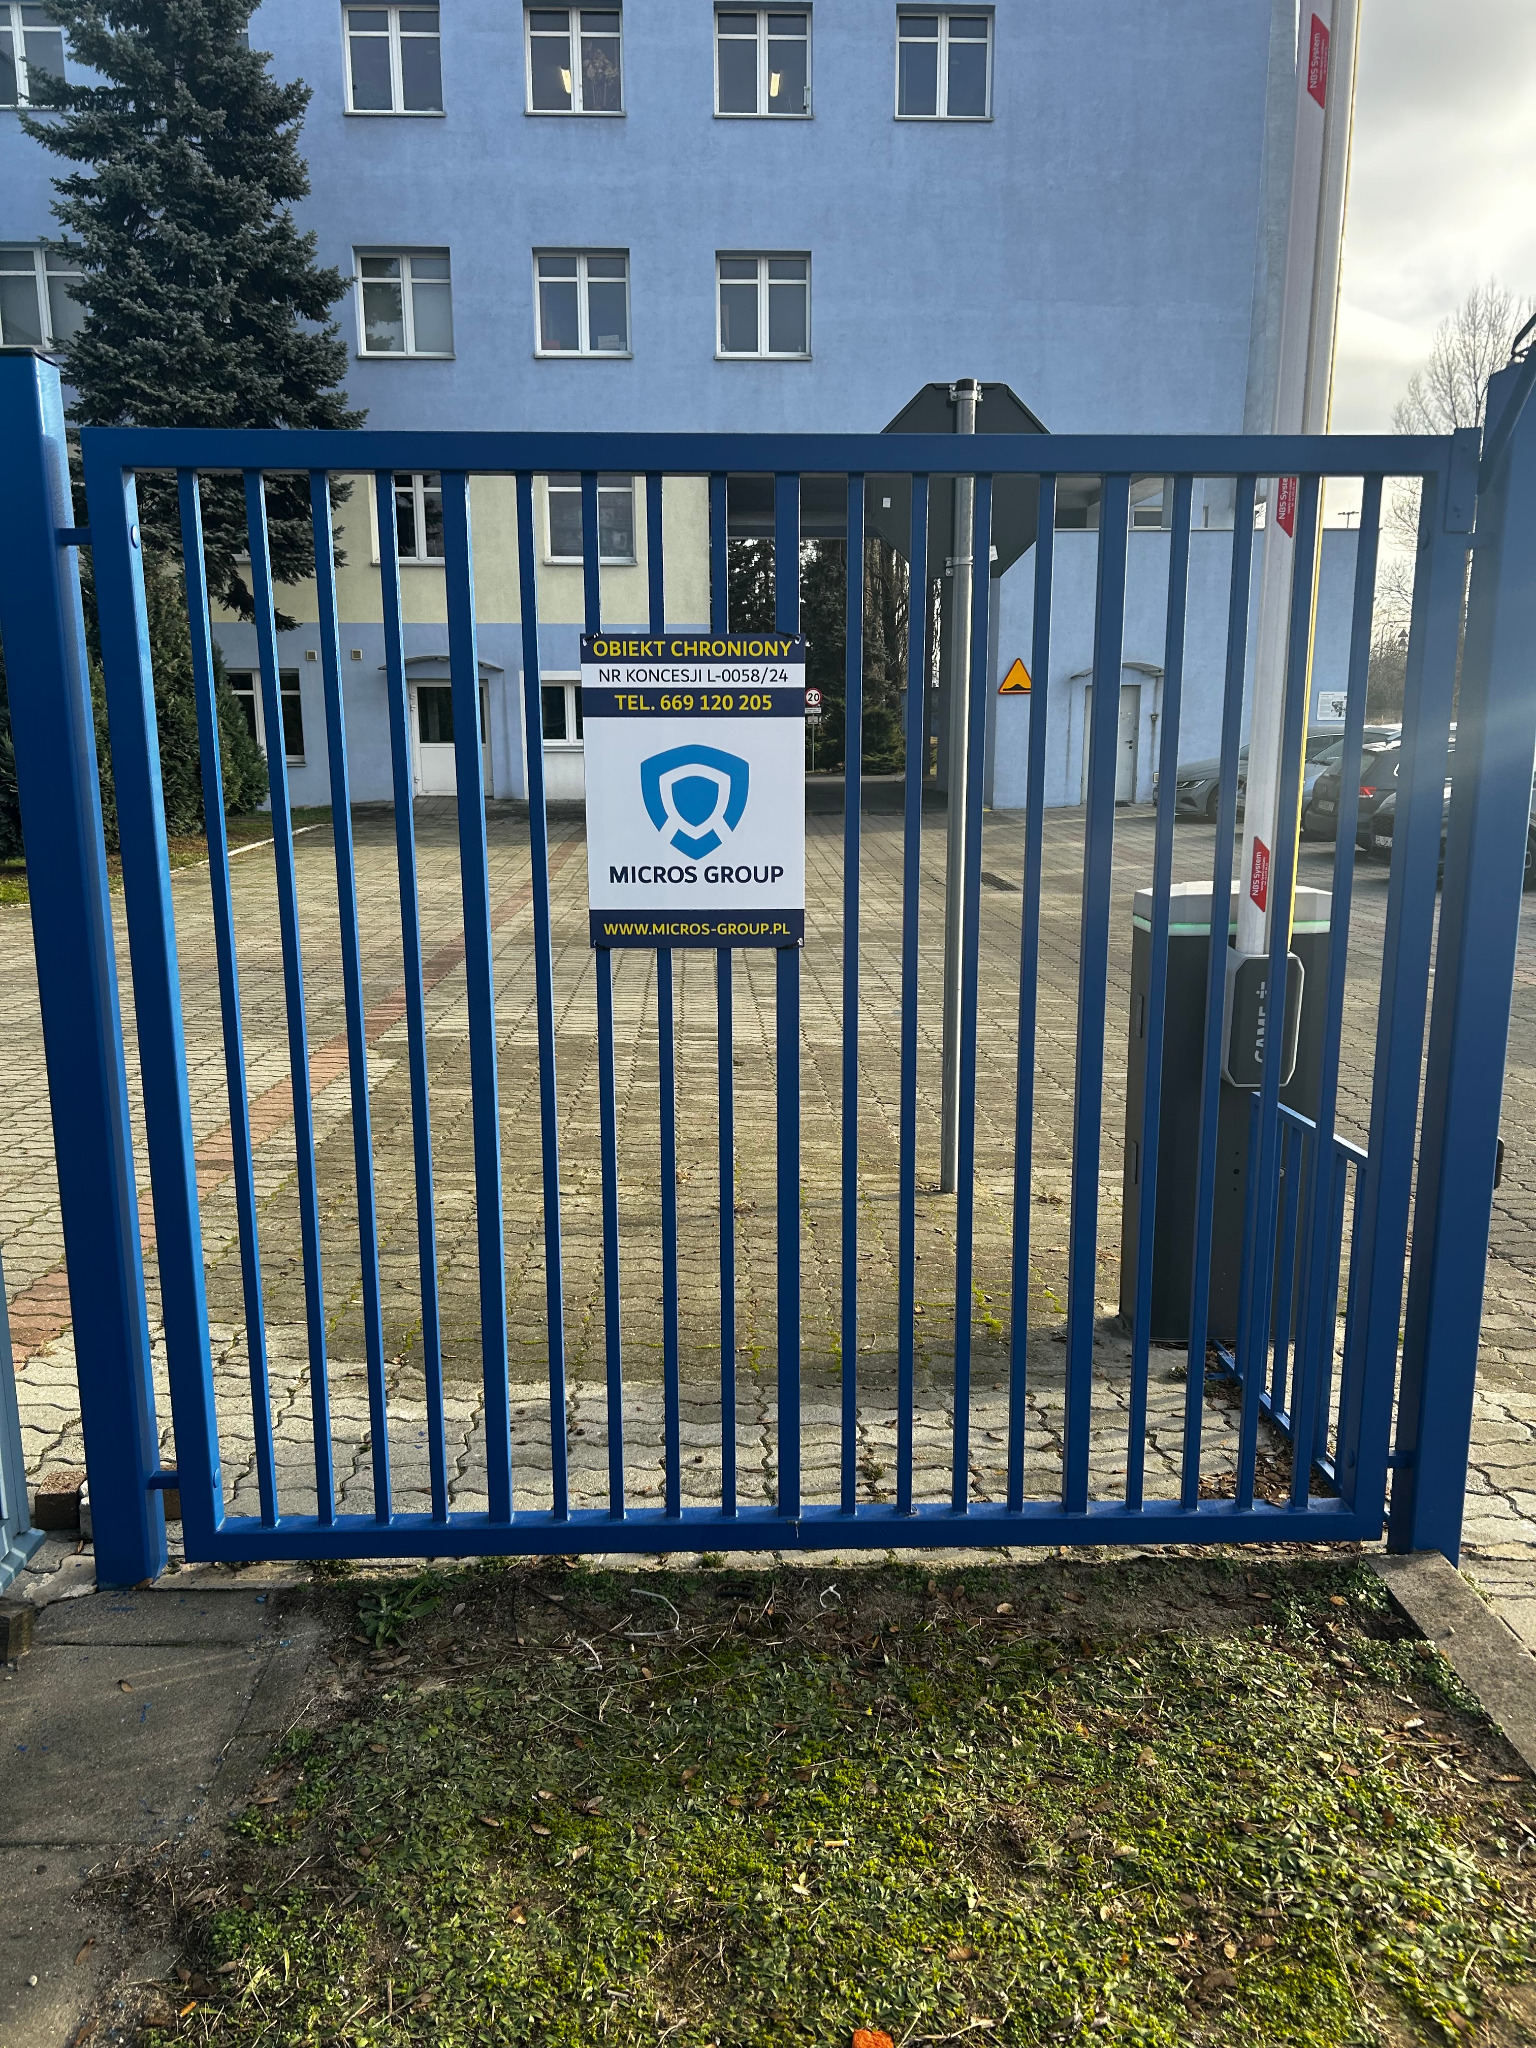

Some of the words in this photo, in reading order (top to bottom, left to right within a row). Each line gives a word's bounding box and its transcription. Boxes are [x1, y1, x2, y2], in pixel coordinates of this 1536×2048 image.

[1312, 32, 1320, 66] System
[1310, 68, 1318, 88] NBS
[1280, 477, 1288, 498] Syste
[1278, 500, 1286, 520] NBS
[593, 641, 665, 657] OBIEKT
[671, 640, 792, 657] CHRONIONY
[599, 669, 621, 682] NR
[626, 668, 702, 683] KONCESJI
[707, 667, 788, 684] L-0058/24
[614, 695, 655, 710] TEL.
[660, 695, 694, 711] 669
[700, 694, 733, 711] 120
[739, 694, 772, 710] 205
[808, 692, 820, 702] 20
[1254, 852, 1262, 878] System
[610, 866, 698, 883] MICROS
[704, 866, 784, 883] GROUP
[1252, 880, 1260, 896] NBS
[604, 923, 790, 935] WWW.MICROS-GROUP.PL
